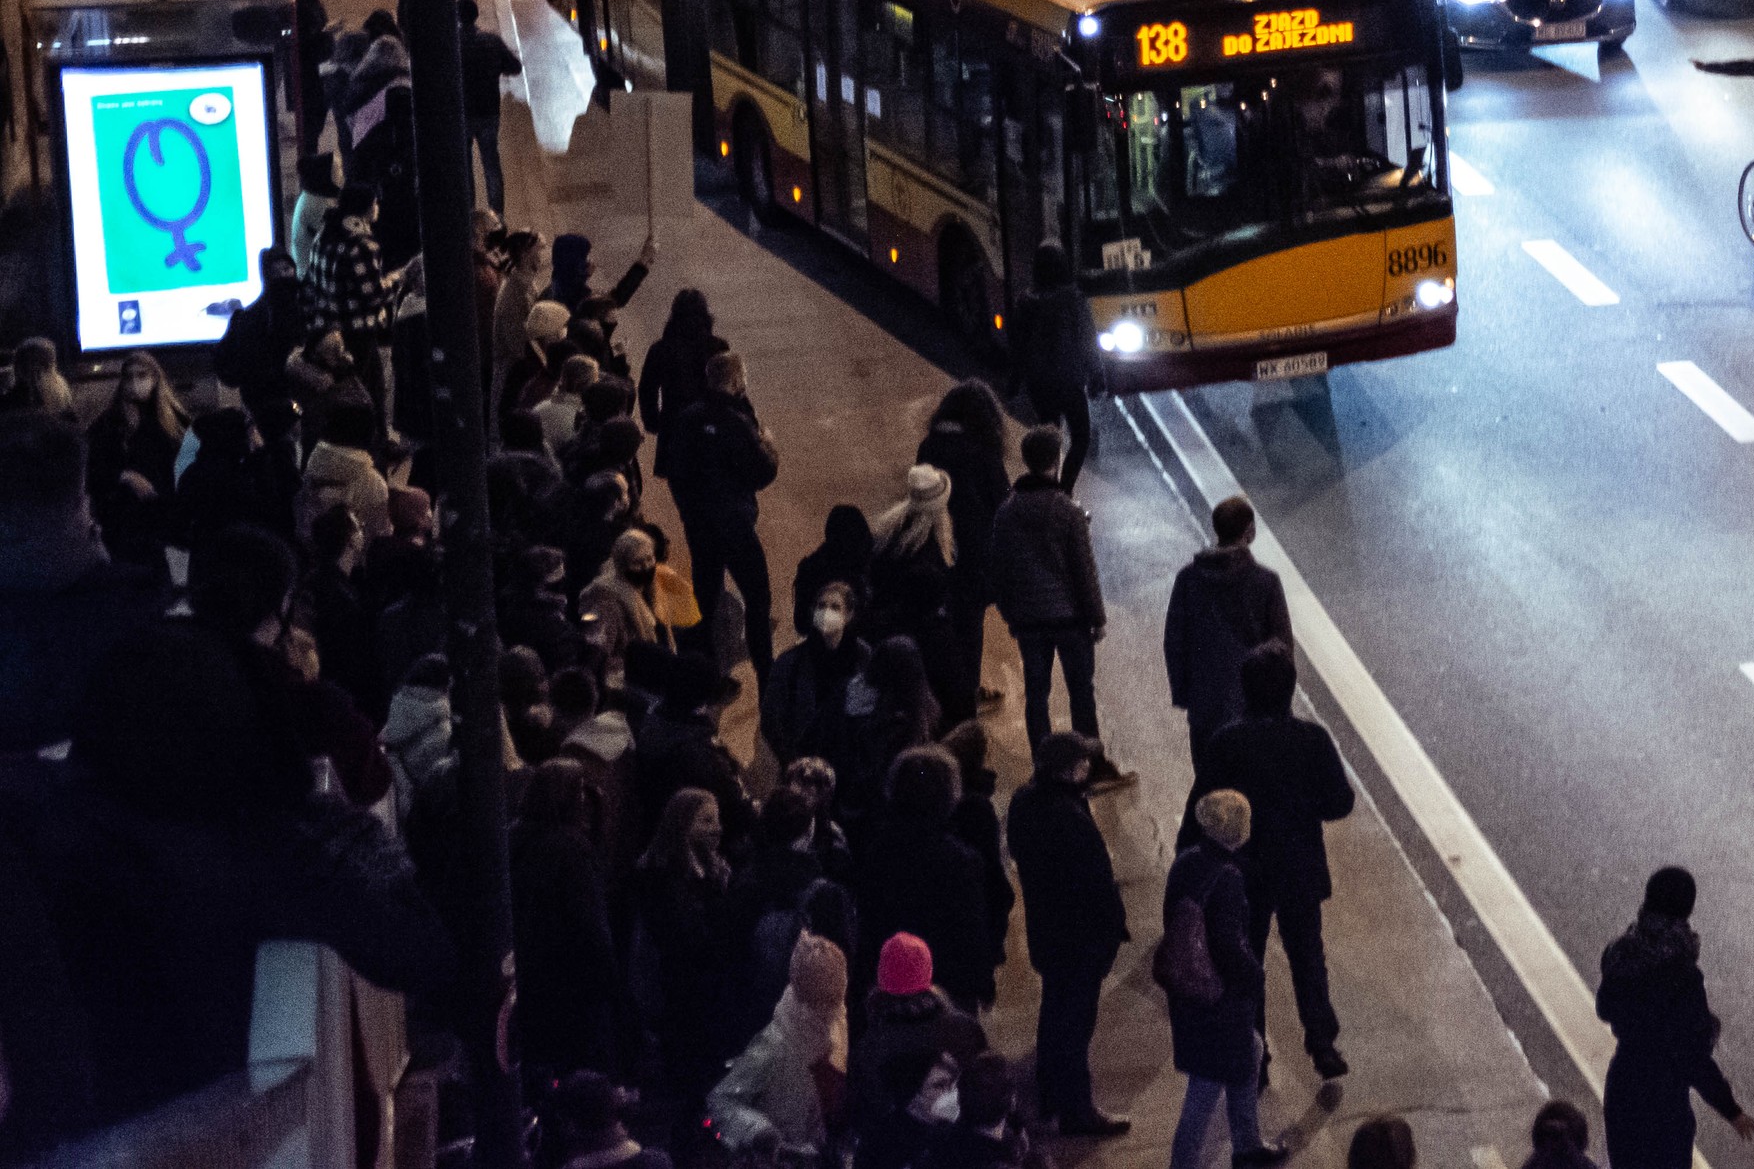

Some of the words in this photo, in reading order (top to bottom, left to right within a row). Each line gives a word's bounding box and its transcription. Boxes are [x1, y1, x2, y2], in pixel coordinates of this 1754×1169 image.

[1222, 33, 1253, 57] DO
[1255, 21, 1354, 53] ZAJEZDNI
[1253, 8, 1320, 35] ZJAZD
[1136, 20, 1188, 66] 138
[1388, 240, 1447, 277] 8896
